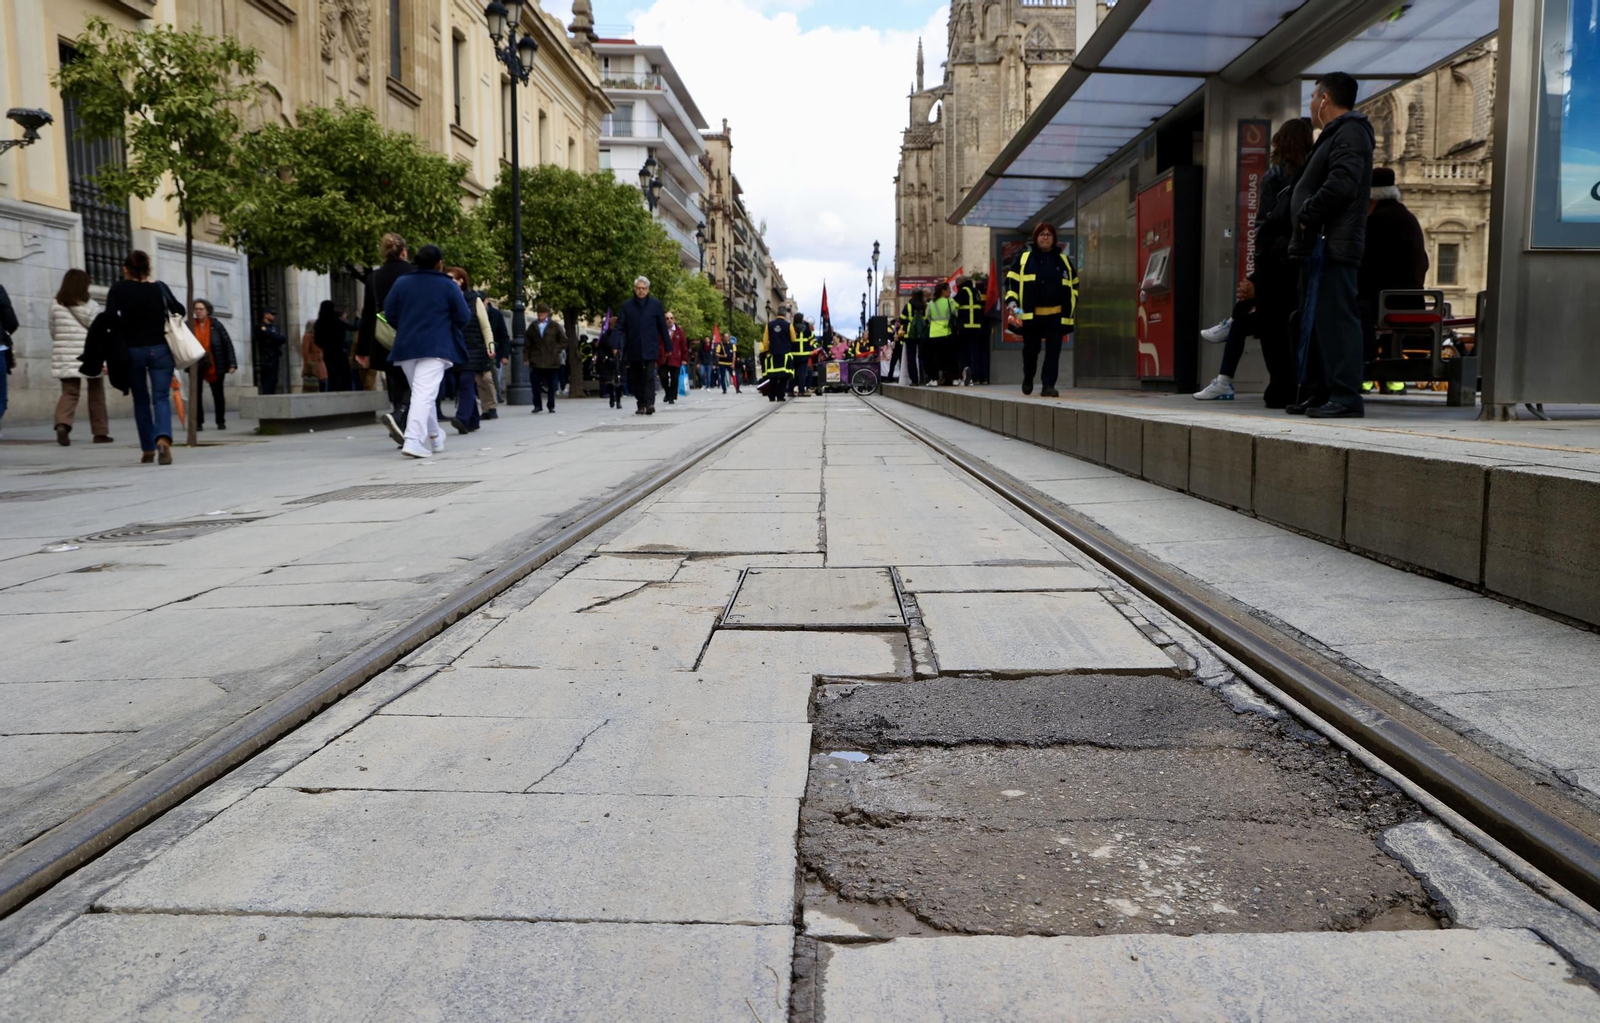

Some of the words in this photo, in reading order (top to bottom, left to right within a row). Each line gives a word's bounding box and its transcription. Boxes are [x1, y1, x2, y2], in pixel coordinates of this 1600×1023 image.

[1248, 173, 1258, 210] INDIAS
[1247, 212, 1257, 227] DE
[1246, 229, 1256, 277] ARCHIVO
